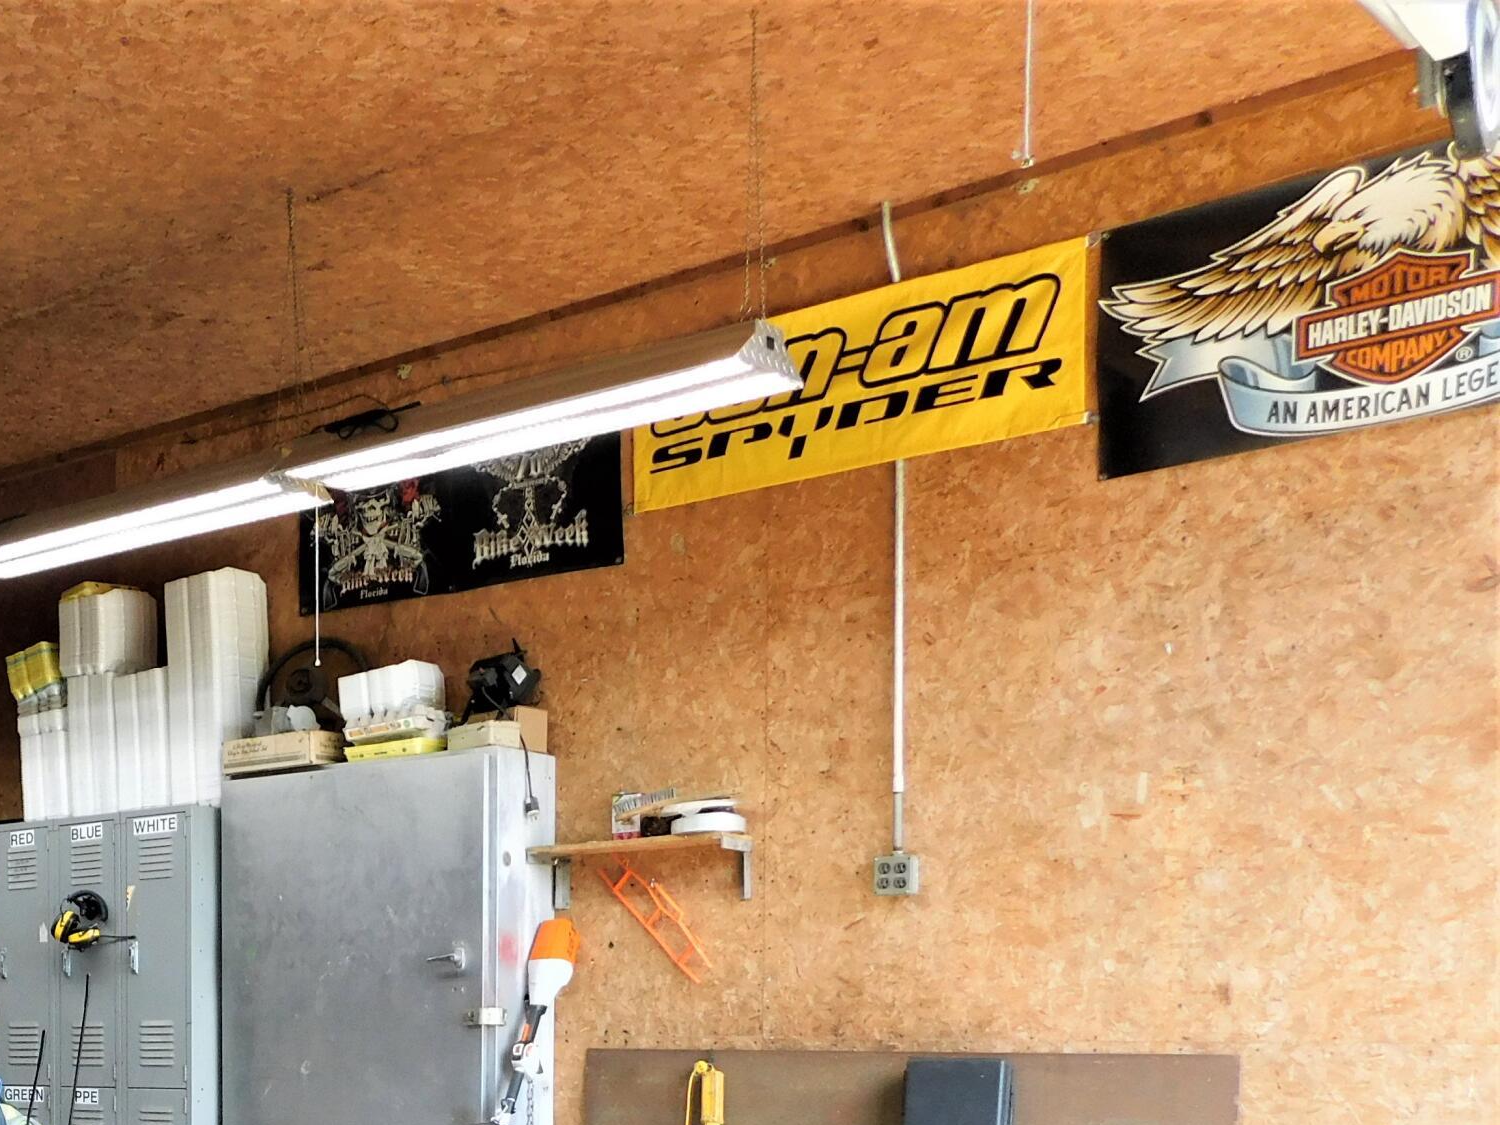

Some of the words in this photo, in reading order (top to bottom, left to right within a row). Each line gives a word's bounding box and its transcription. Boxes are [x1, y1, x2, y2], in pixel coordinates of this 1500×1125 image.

[1350, 262, 1450, 302] MOTOR
[1307, 283, 1492, 350] HARLEY-DAVIDSON
[650, 272, 1061, 438] n-am
[1346, 330, 1450, 373] COMPANY
[650, 357, 1063, 474] SPYDER
[1266, 400, 1298, 424] AN
[1305, 382, 1431, 424] AMERICAN
[359, 587, 388, 600] Florida
[10, 832, 34, 846] RED
[71, 824, 102, 841] BLUE
[134, 816, 176, 834] WHITE
[4, 1088, 43, 1101] GREEN
[74, 1090, 98, 1103] PPE
